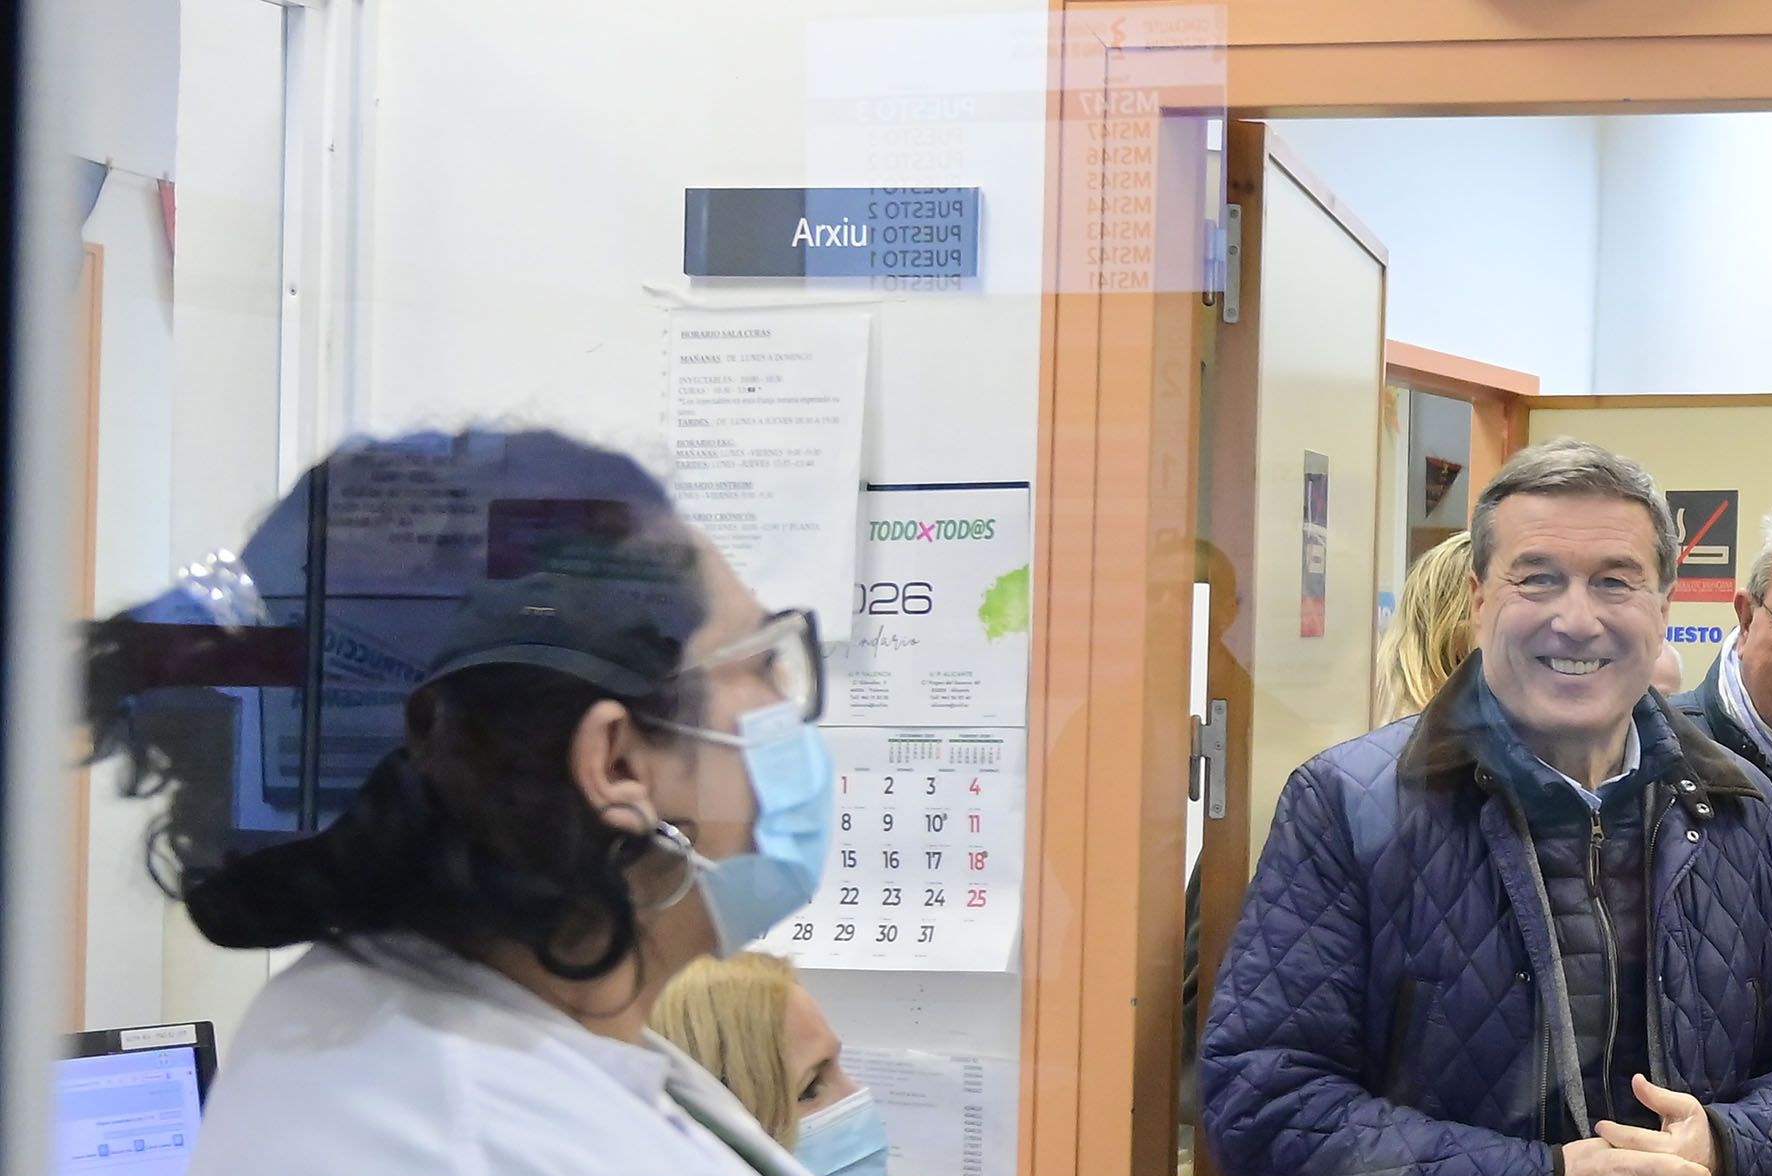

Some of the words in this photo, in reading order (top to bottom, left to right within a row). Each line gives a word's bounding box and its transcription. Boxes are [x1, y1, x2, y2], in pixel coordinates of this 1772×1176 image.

[792, 217, 868, 248] Arxiu
[841, 776, 848, 794] 1
[884, 777, 894, 794] 2
[926, 777, 936, 795] 3
[969, 778, 981, 795] 4
[841, 813, 852, 832] 8
[883, 814, 893, 832] 9
[925, 814, 944, 832] 10
[968, 815, 980, 833] 11
[841, 850, 857, 868] 15
[883, 851, 900, 869] 16
[926, 852, 942, 870] 17
[968, 852, 984, 870] 18
[840, 887, 859, 905] 22
[882, 888, 901, 906] 23
[924, 889, 945, 907] 24
[967, 890, 987, 908] 25
[792, 923, 814, 941] 28
[834, 923, 855, 942] 29
[876, 925, 898, 942] 30
[917, 925, 934, 943] 31
